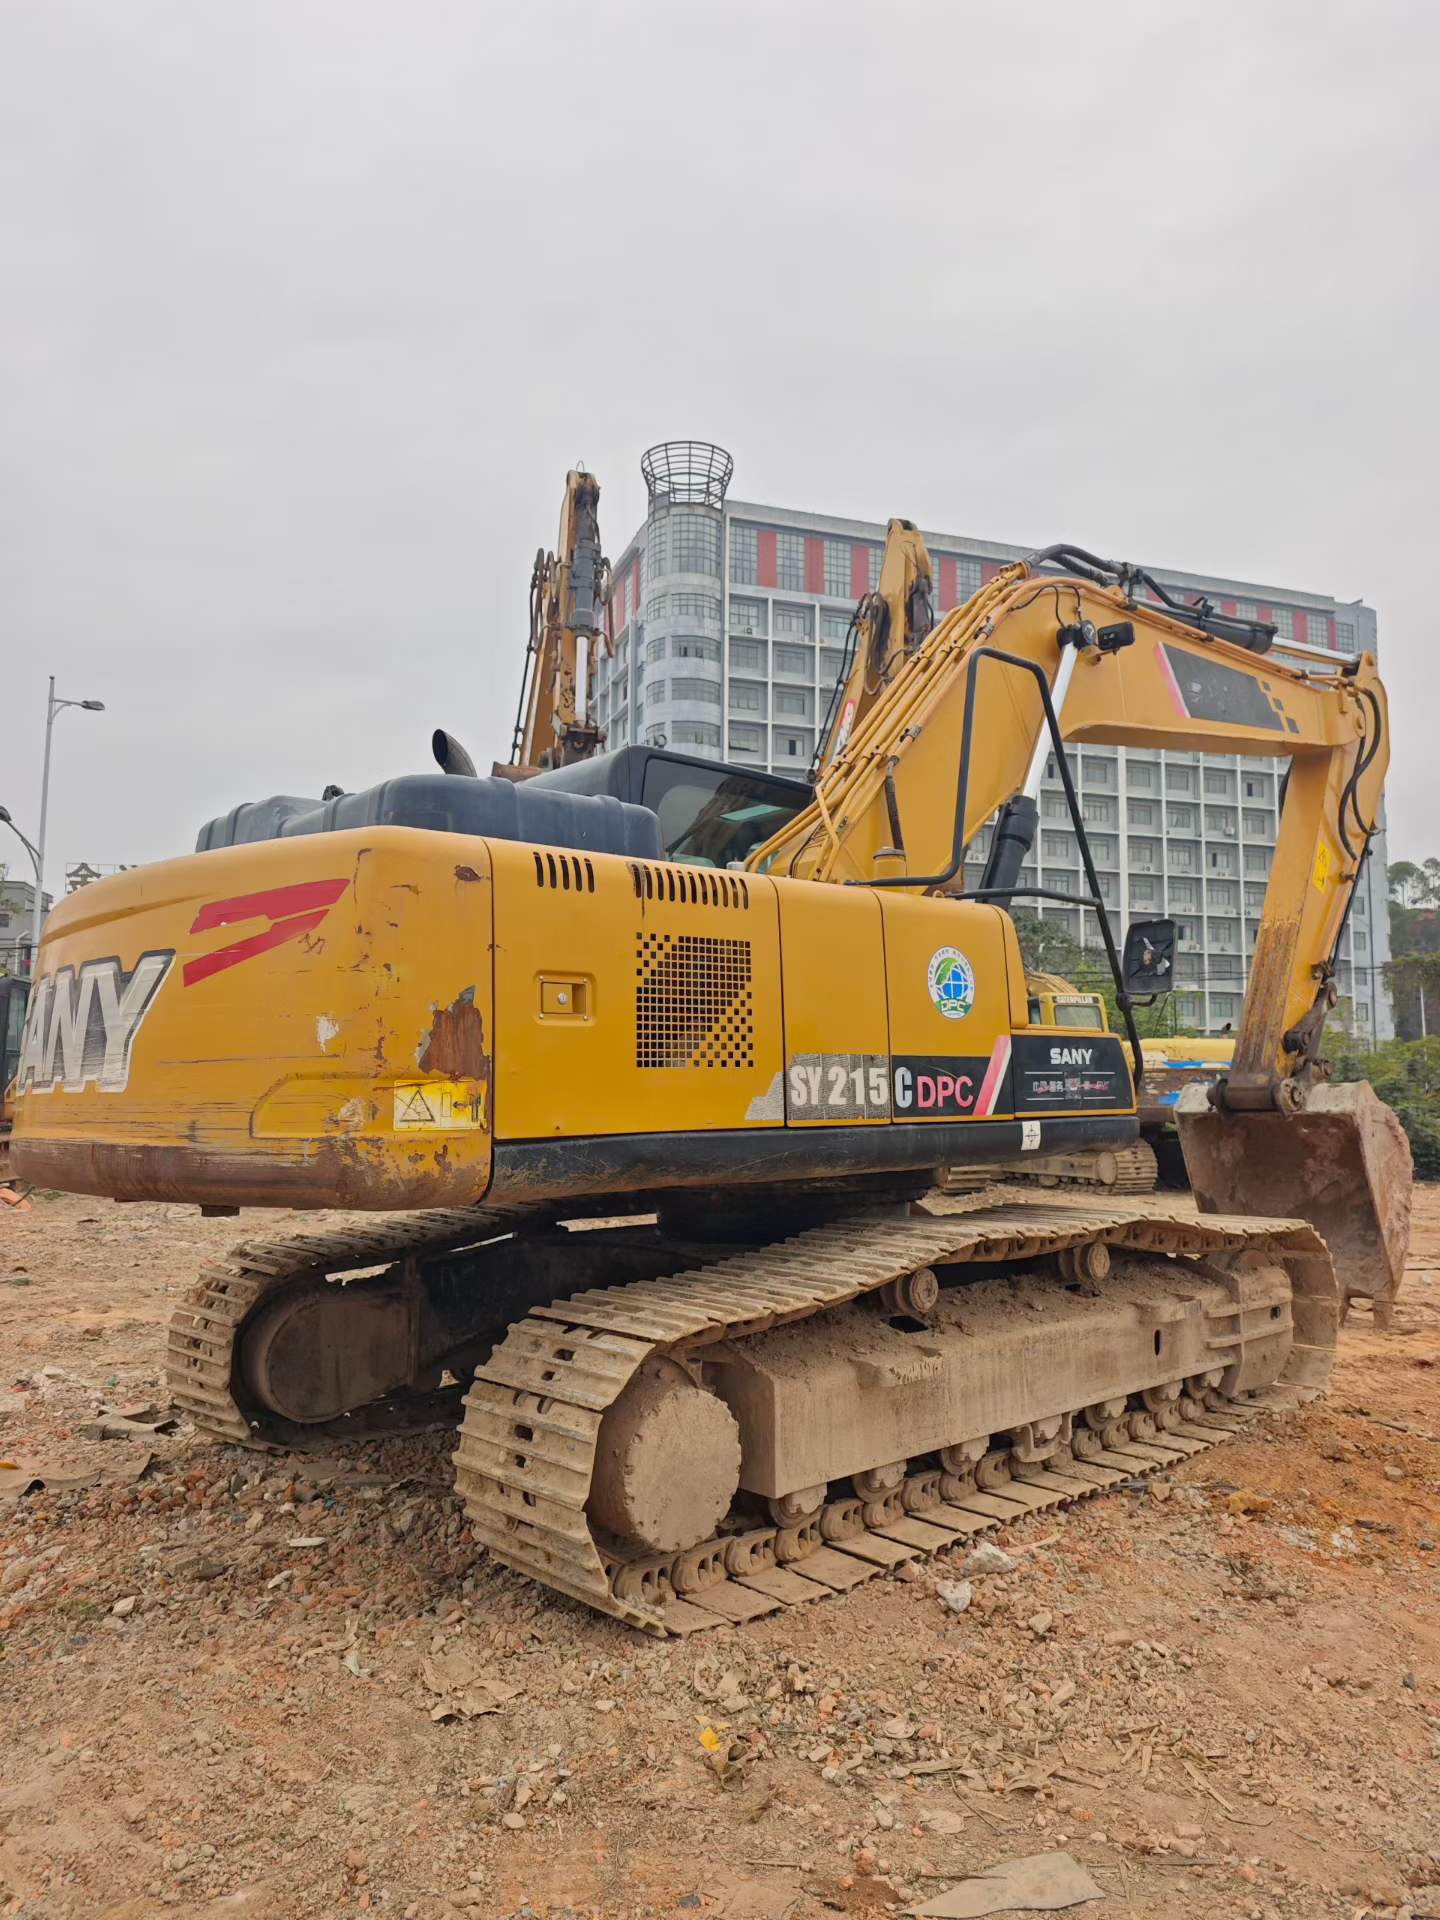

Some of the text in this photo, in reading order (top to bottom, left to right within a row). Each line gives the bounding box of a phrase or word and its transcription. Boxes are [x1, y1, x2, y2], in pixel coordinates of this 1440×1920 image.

[941, 999, 966, 1011] DPC
[15, 948, 177, 1096] ANY
[1050, 1047, 1092, 1065] SANY
[917, 1075, 974, 1108] DPC
